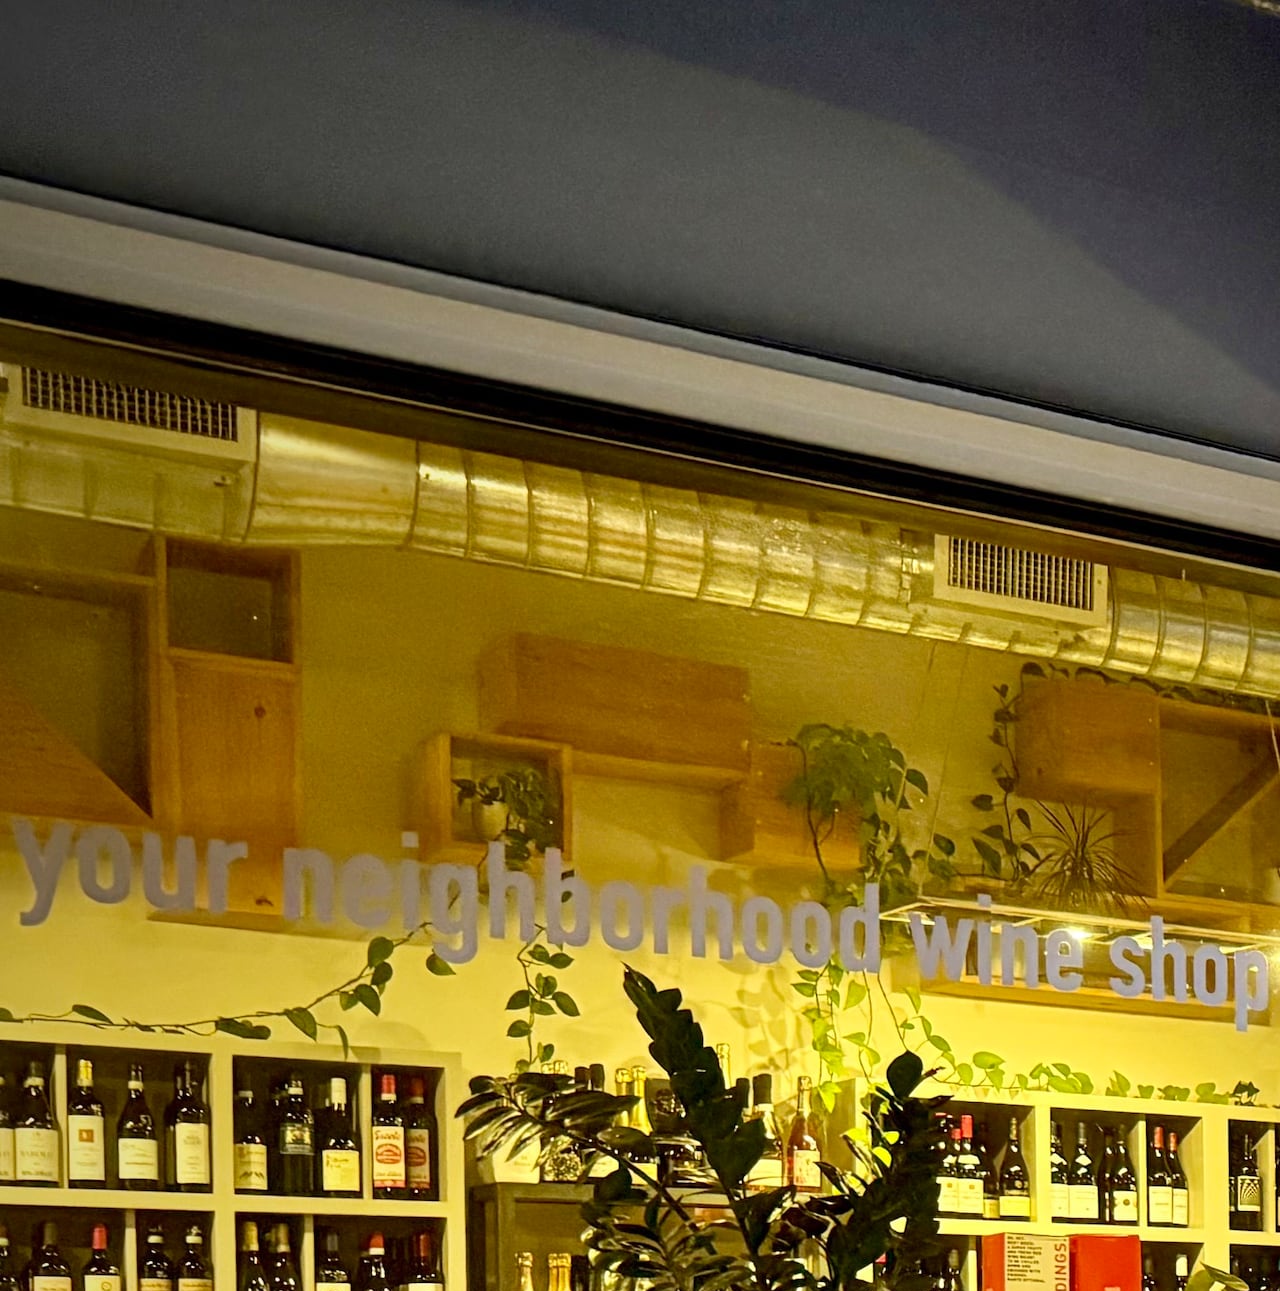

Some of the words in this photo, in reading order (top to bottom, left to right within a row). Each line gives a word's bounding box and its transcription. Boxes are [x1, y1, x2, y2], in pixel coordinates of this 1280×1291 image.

[12, 819, 248, 927] your
[282, 832, 880, 974] neighborhood
[910, 893, 1083, 992] wine
[1110, 915, 1270, 1032] shop
